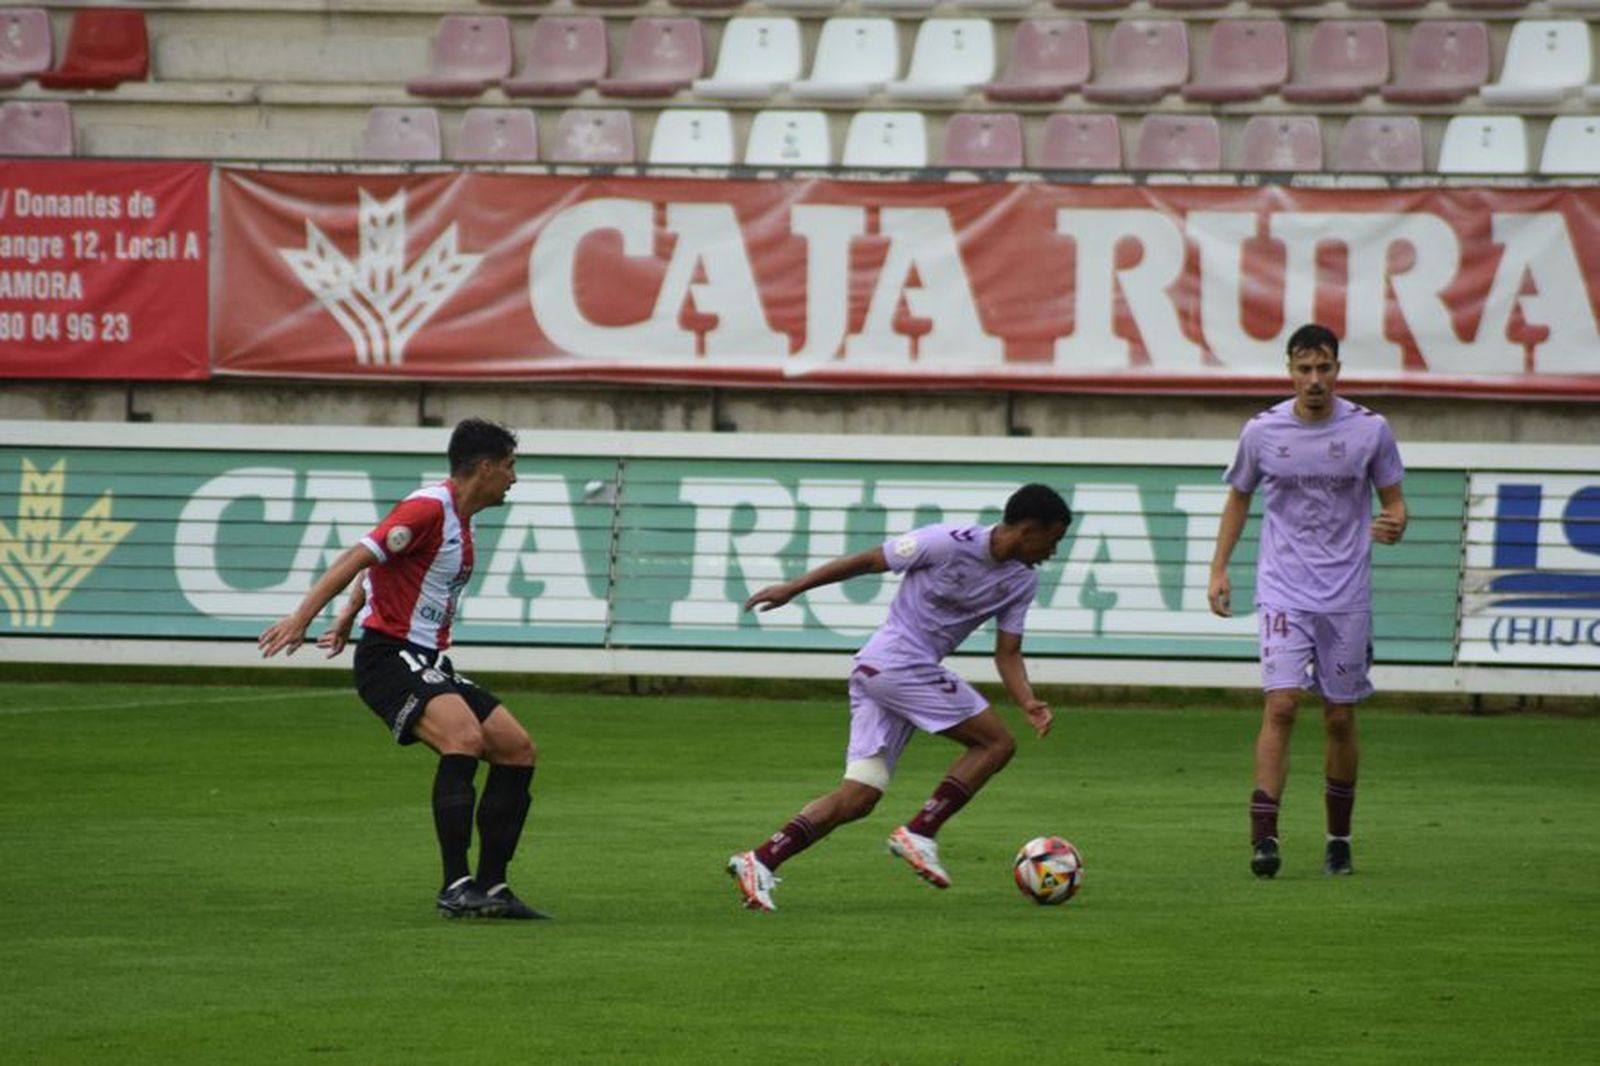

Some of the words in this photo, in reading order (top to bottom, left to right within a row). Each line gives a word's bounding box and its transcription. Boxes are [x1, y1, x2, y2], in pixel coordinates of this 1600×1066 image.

[15, 188, 120, 217] Donantes
[127, 191, 155, 217] de
[0, 235, 63, 263] angre
[115, 231, 177, 259] Local
[184, 231, 199, 259] A
[0, 271, 82, 299] AMORA
[529, 198, 1004, 375] CAJA
[1053, 208, 1600, 374] RURA
[32, 313, 59, 340] 04
[67, 313, 95, 341] 96
[102, 313, 129, 341] 23
[174, 467, 608, 627] CAA
[1263, 609, 1291, 638] 14
